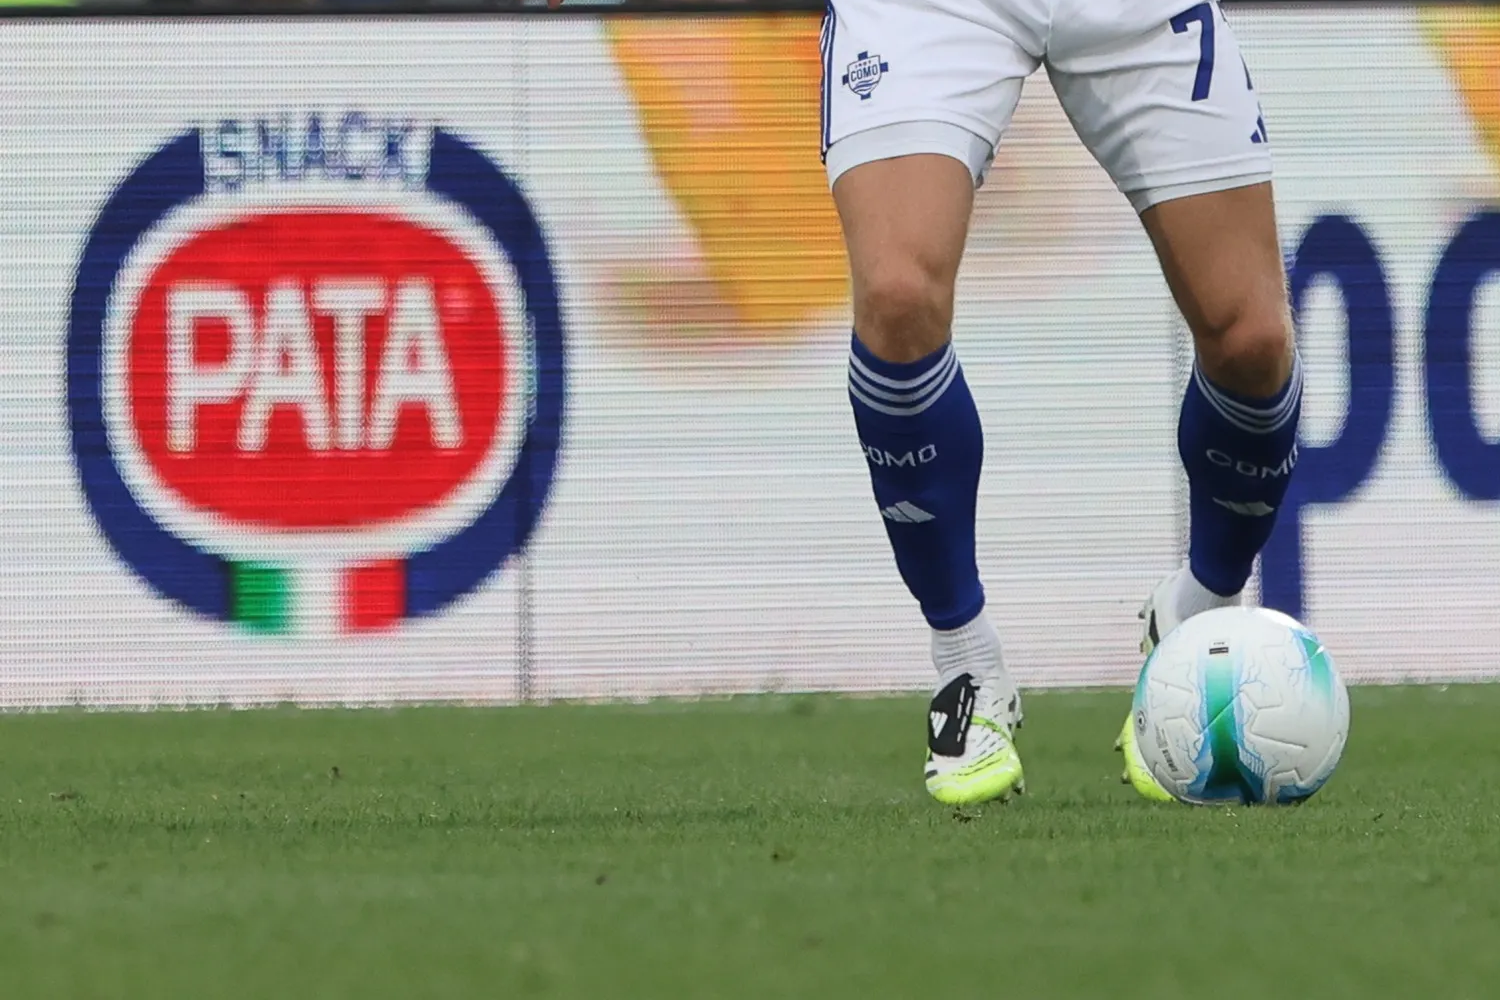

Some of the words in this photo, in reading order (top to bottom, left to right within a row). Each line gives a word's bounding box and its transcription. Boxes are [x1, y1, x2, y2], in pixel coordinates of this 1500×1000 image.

[850, 63, 879, 82] COMO
[1168, 1, 1216, 102] 7
[164, 274, 465, 455] PATA
